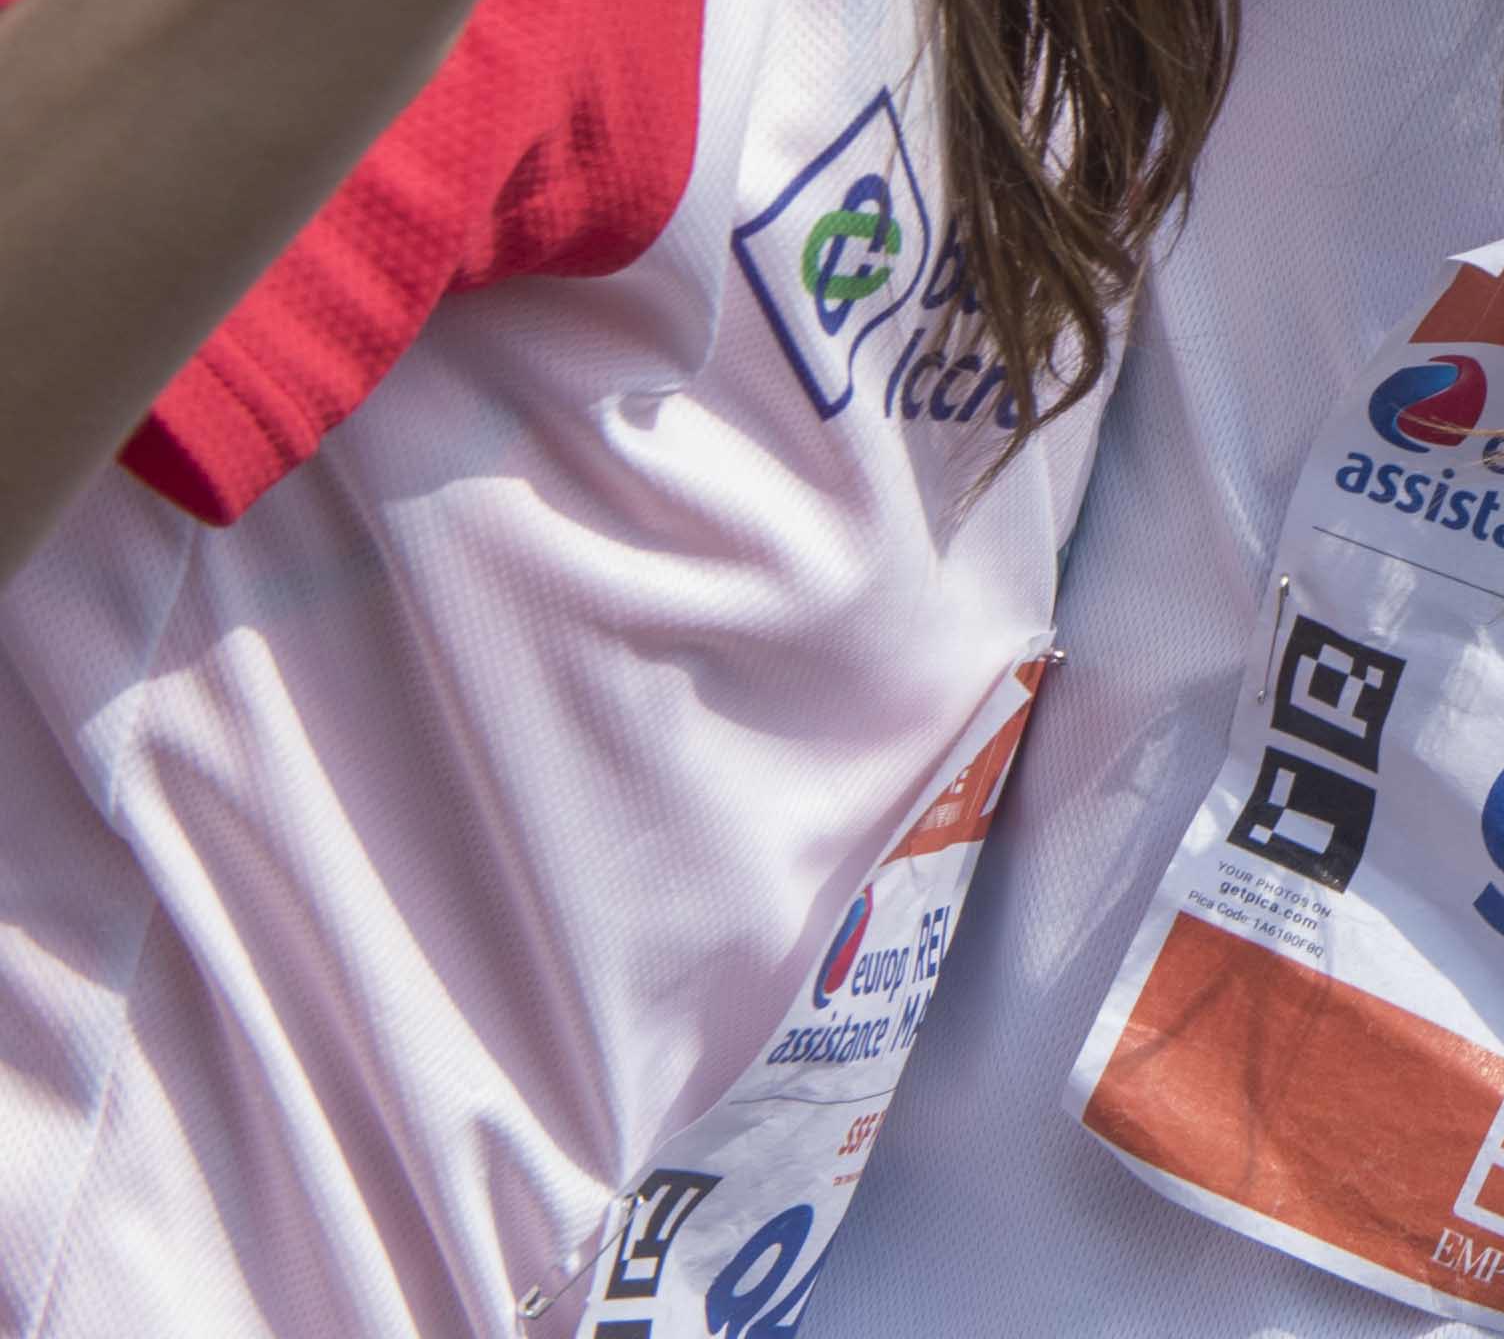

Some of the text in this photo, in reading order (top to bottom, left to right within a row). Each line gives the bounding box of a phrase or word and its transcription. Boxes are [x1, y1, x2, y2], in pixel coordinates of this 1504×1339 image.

[1188, 890, 1215, 909] Pica
[1218, 860, 1332, 918] YOUR PHOTOS ON
[1220, 881, 1318, 931] getpica.com
[851, 947, 910, 1003] europ
[766, 1011, 890, 1065] assistance
